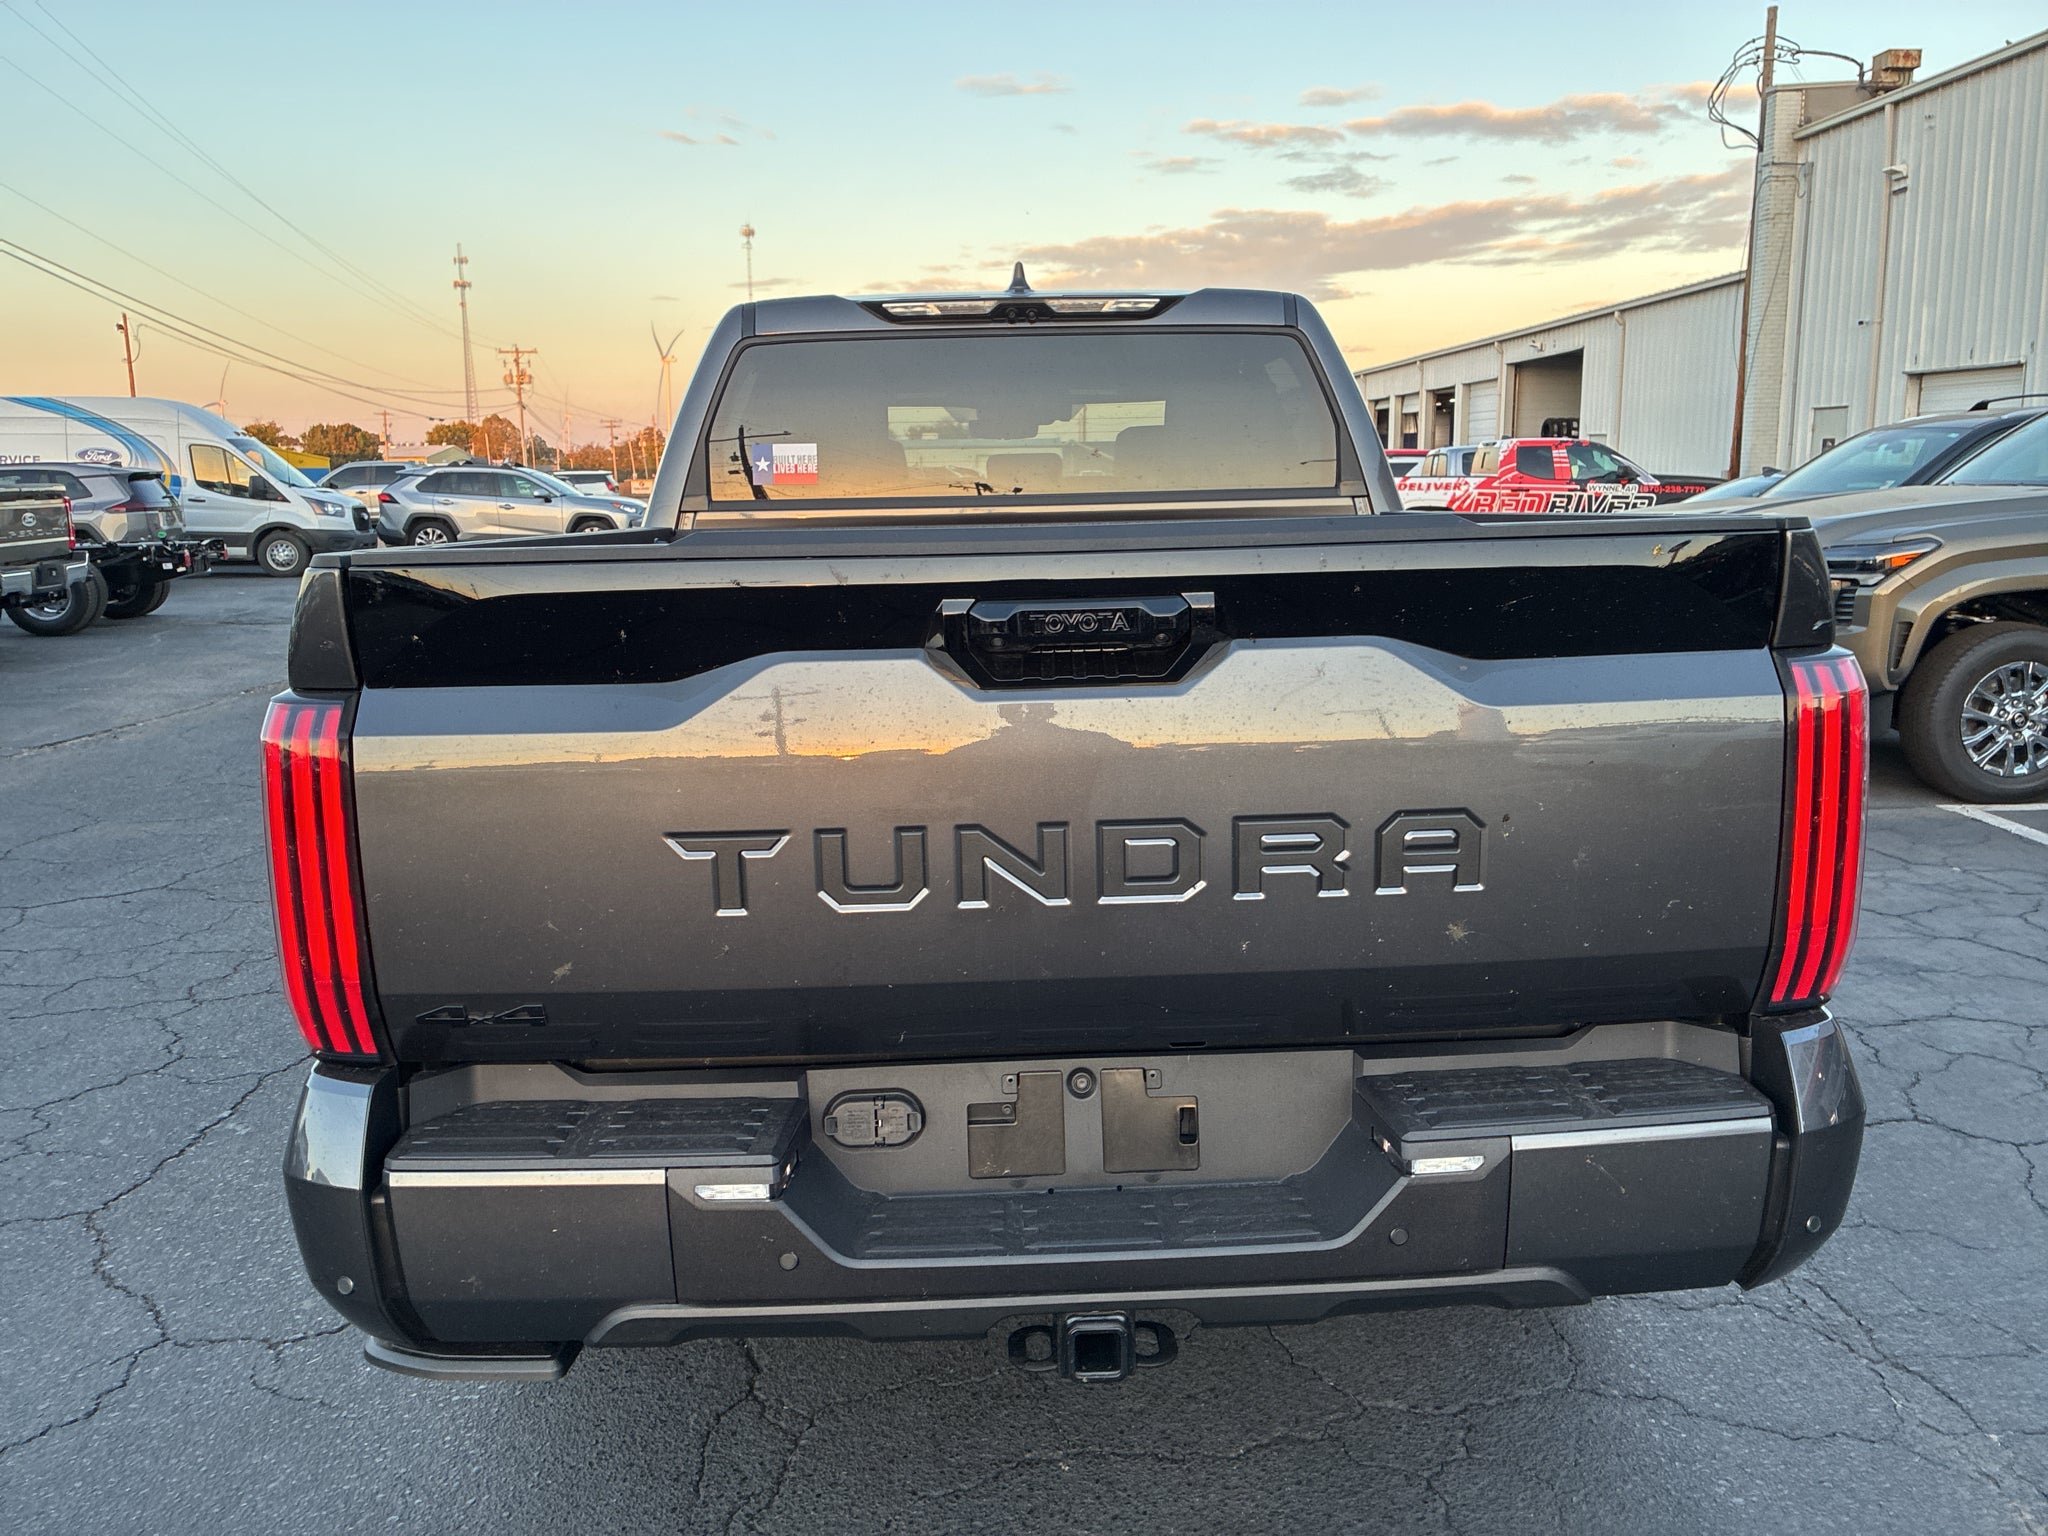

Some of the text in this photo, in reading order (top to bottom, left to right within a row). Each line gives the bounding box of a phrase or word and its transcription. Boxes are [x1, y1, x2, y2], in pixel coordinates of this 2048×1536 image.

[83, 448, 115, 462] Ford
[773, 455, 818, 464] BUILT HERE
[773, 464, 818, 474] LIVES HERE
[1625, 484, 1638, 493] AR
[1028, 611, 1130, 634] TOYOTA
[661, 807, 1489, 917] TUNDRA
